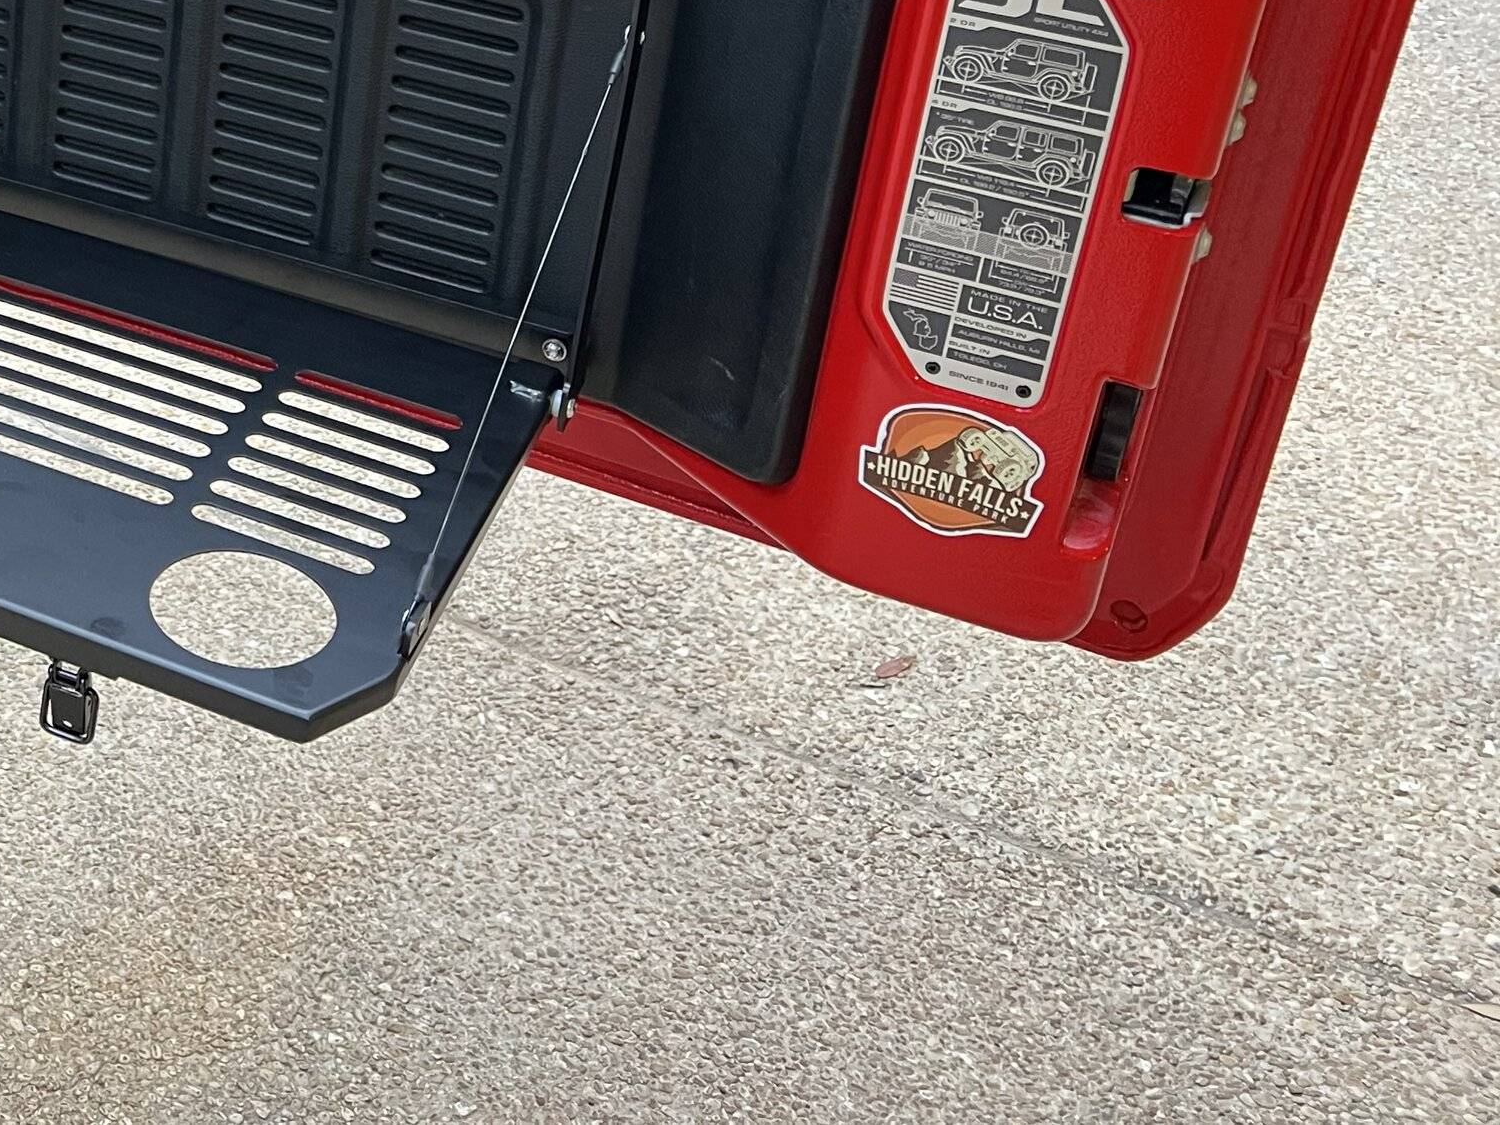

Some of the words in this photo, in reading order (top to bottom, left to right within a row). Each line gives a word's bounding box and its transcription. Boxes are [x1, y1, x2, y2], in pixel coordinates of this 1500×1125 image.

[967, 296, 1043, 330] U.S.A.
[970, 289, 1005, 303] MADE
[1009, 299, 1021, 308] IN
[1025, 303, 1048, 314] THE
[954, 316, 1014, 336] DEVELOPED
[958, 329, 997, 344] AUBURN
[948, 340, 977, 352] BUILT
[948, 370, 984, 385] SINCE
[986, 380, 1009, 391] 1941
[876, 454, 954, 495] HIDDEN
[958, 480, 1023, 518] FALLS
[881, 476, 964, 508] ADVENTURE
[972, 504, 1010, 525] PARK
